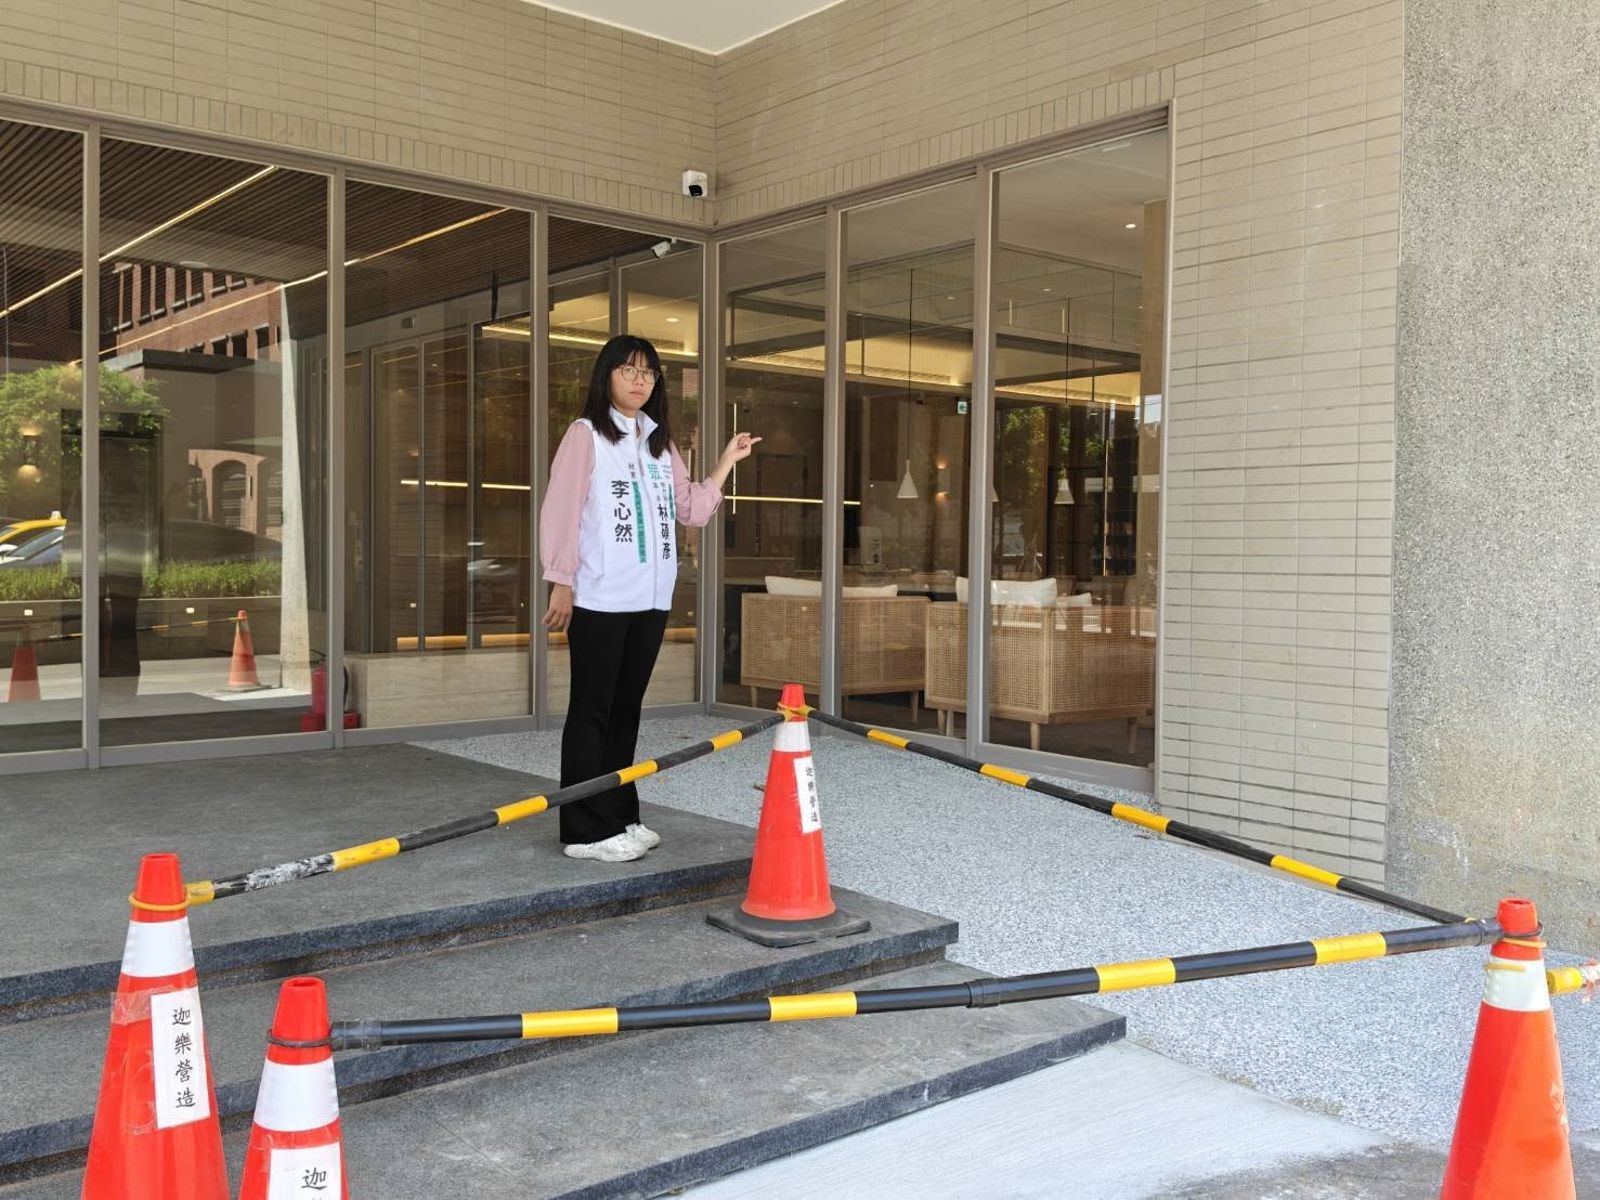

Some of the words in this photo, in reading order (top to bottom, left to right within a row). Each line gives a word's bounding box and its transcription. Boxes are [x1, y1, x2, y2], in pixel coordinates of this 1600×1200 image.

[611, 480, 633, 543] 李心然
[172, 1007, 196, 1109] 迦樂營造
[301, 1167, 328, 1200] 迦
